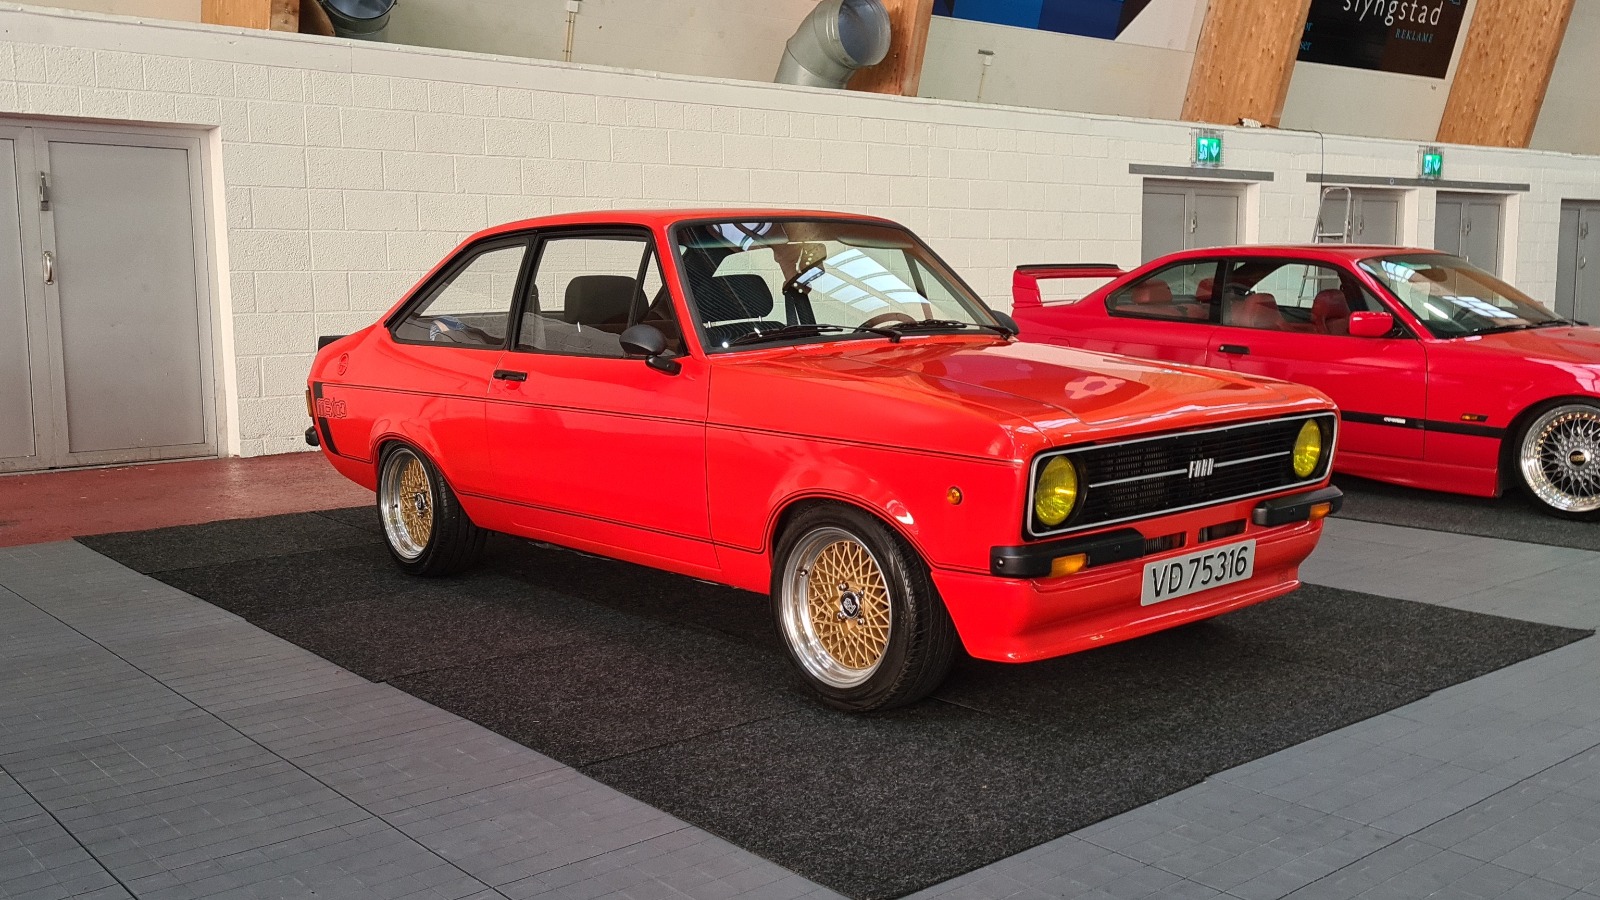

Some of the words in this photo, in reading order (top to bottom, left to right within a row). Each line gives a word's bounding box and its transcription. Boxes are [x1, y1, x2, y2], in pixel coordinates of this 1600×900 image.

[1395, 28, 1434, 43] REKLAME
[1152, 563, 1184, 598] VD
[1188, 546, 1249, 589] 75316
